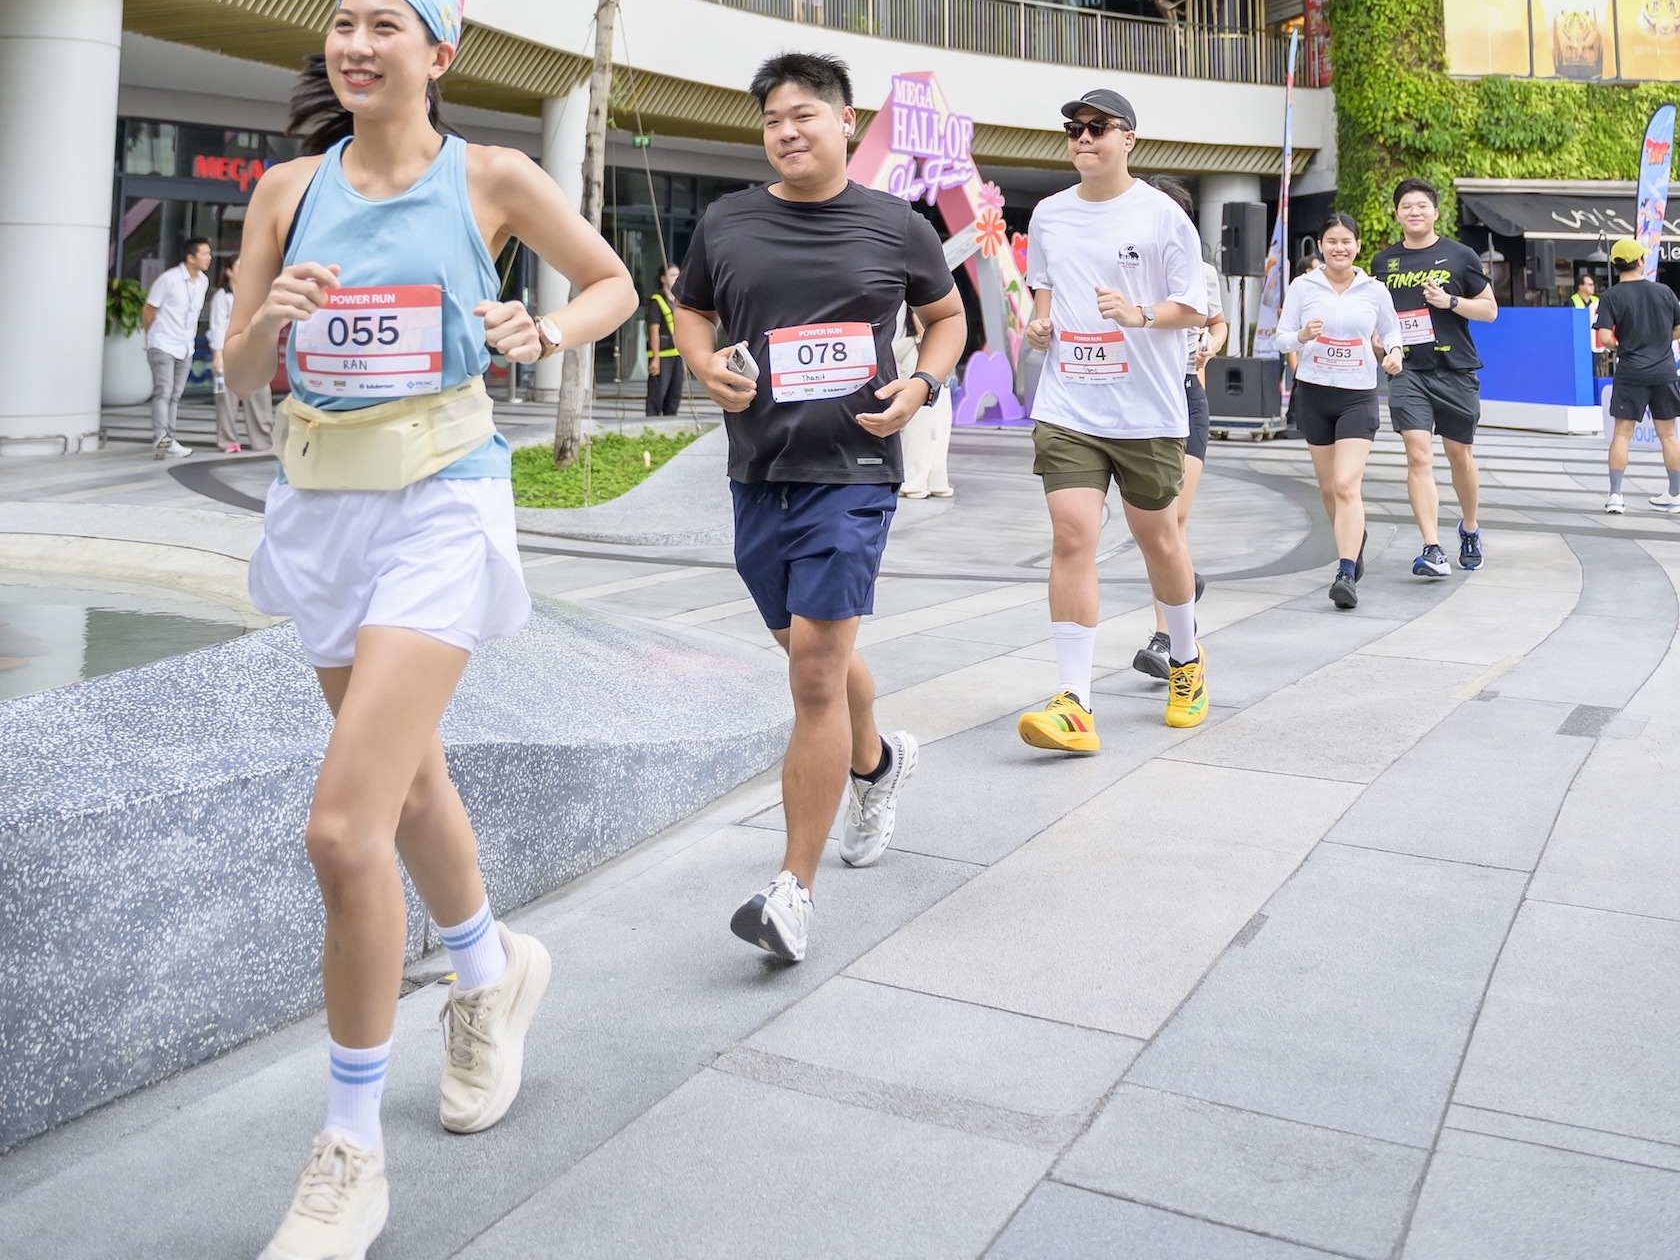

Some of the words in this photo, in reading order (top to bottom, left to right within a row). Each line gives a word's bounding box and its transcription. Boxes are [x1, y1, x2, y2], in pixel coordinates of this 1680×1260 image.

[893, 79, 934, 109] MEGA
[892, 107, 944, 156] HALL
[945, 116, 973, 160] OF
[193, 154, 264, 192] MEGA
[330, 295, 370, 305] POWER
[371, 293, 396, 304] RUN
[327, 315, 400, 347] 055
[797, 342, 848, 365] 078
[1073, 346, 1107, 361] 074
[1327, 347, 1352, 358] 053
[343, 359, 368, 371] RAN
